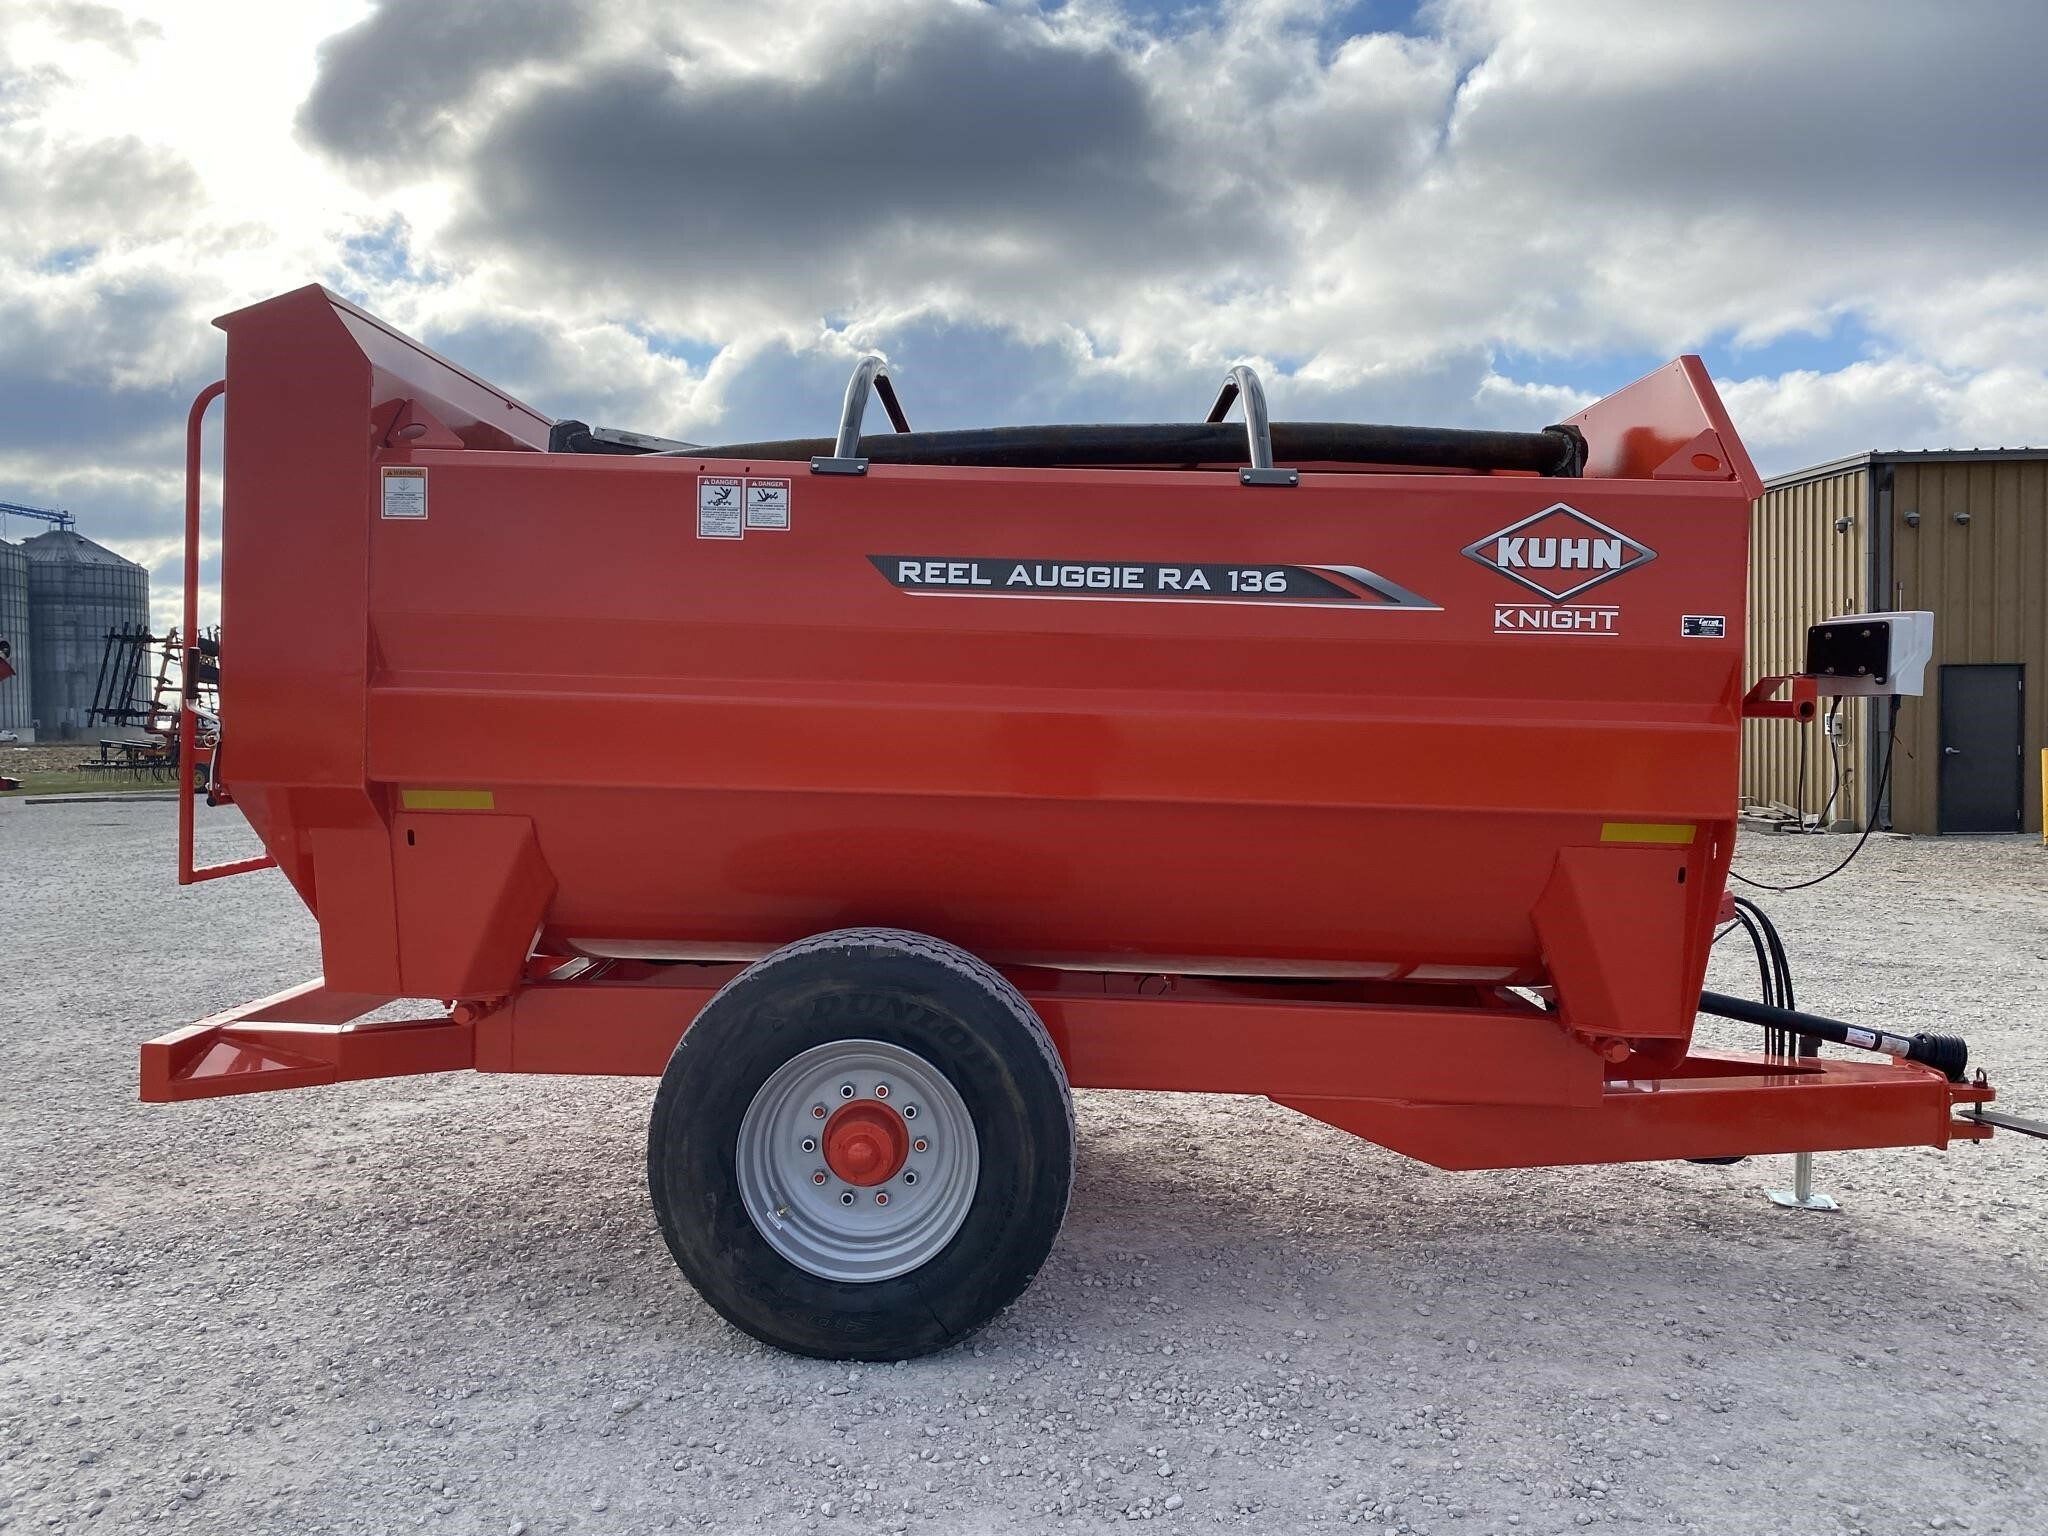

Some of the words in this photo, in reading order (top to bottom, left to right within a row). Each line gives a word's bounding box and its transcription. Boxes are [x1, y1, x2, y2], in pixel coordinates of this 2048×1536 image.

[1497, 538, 1621, 569] KUHN
[899, 561, 992, 585] REEL
[1006, 563, 1144, 590] AUGGIE
[1158, 568, 1211, 591] RA
[1228, 570, 1288, 593] 136
[1495, 610, 1619, 630] KNIGHT
